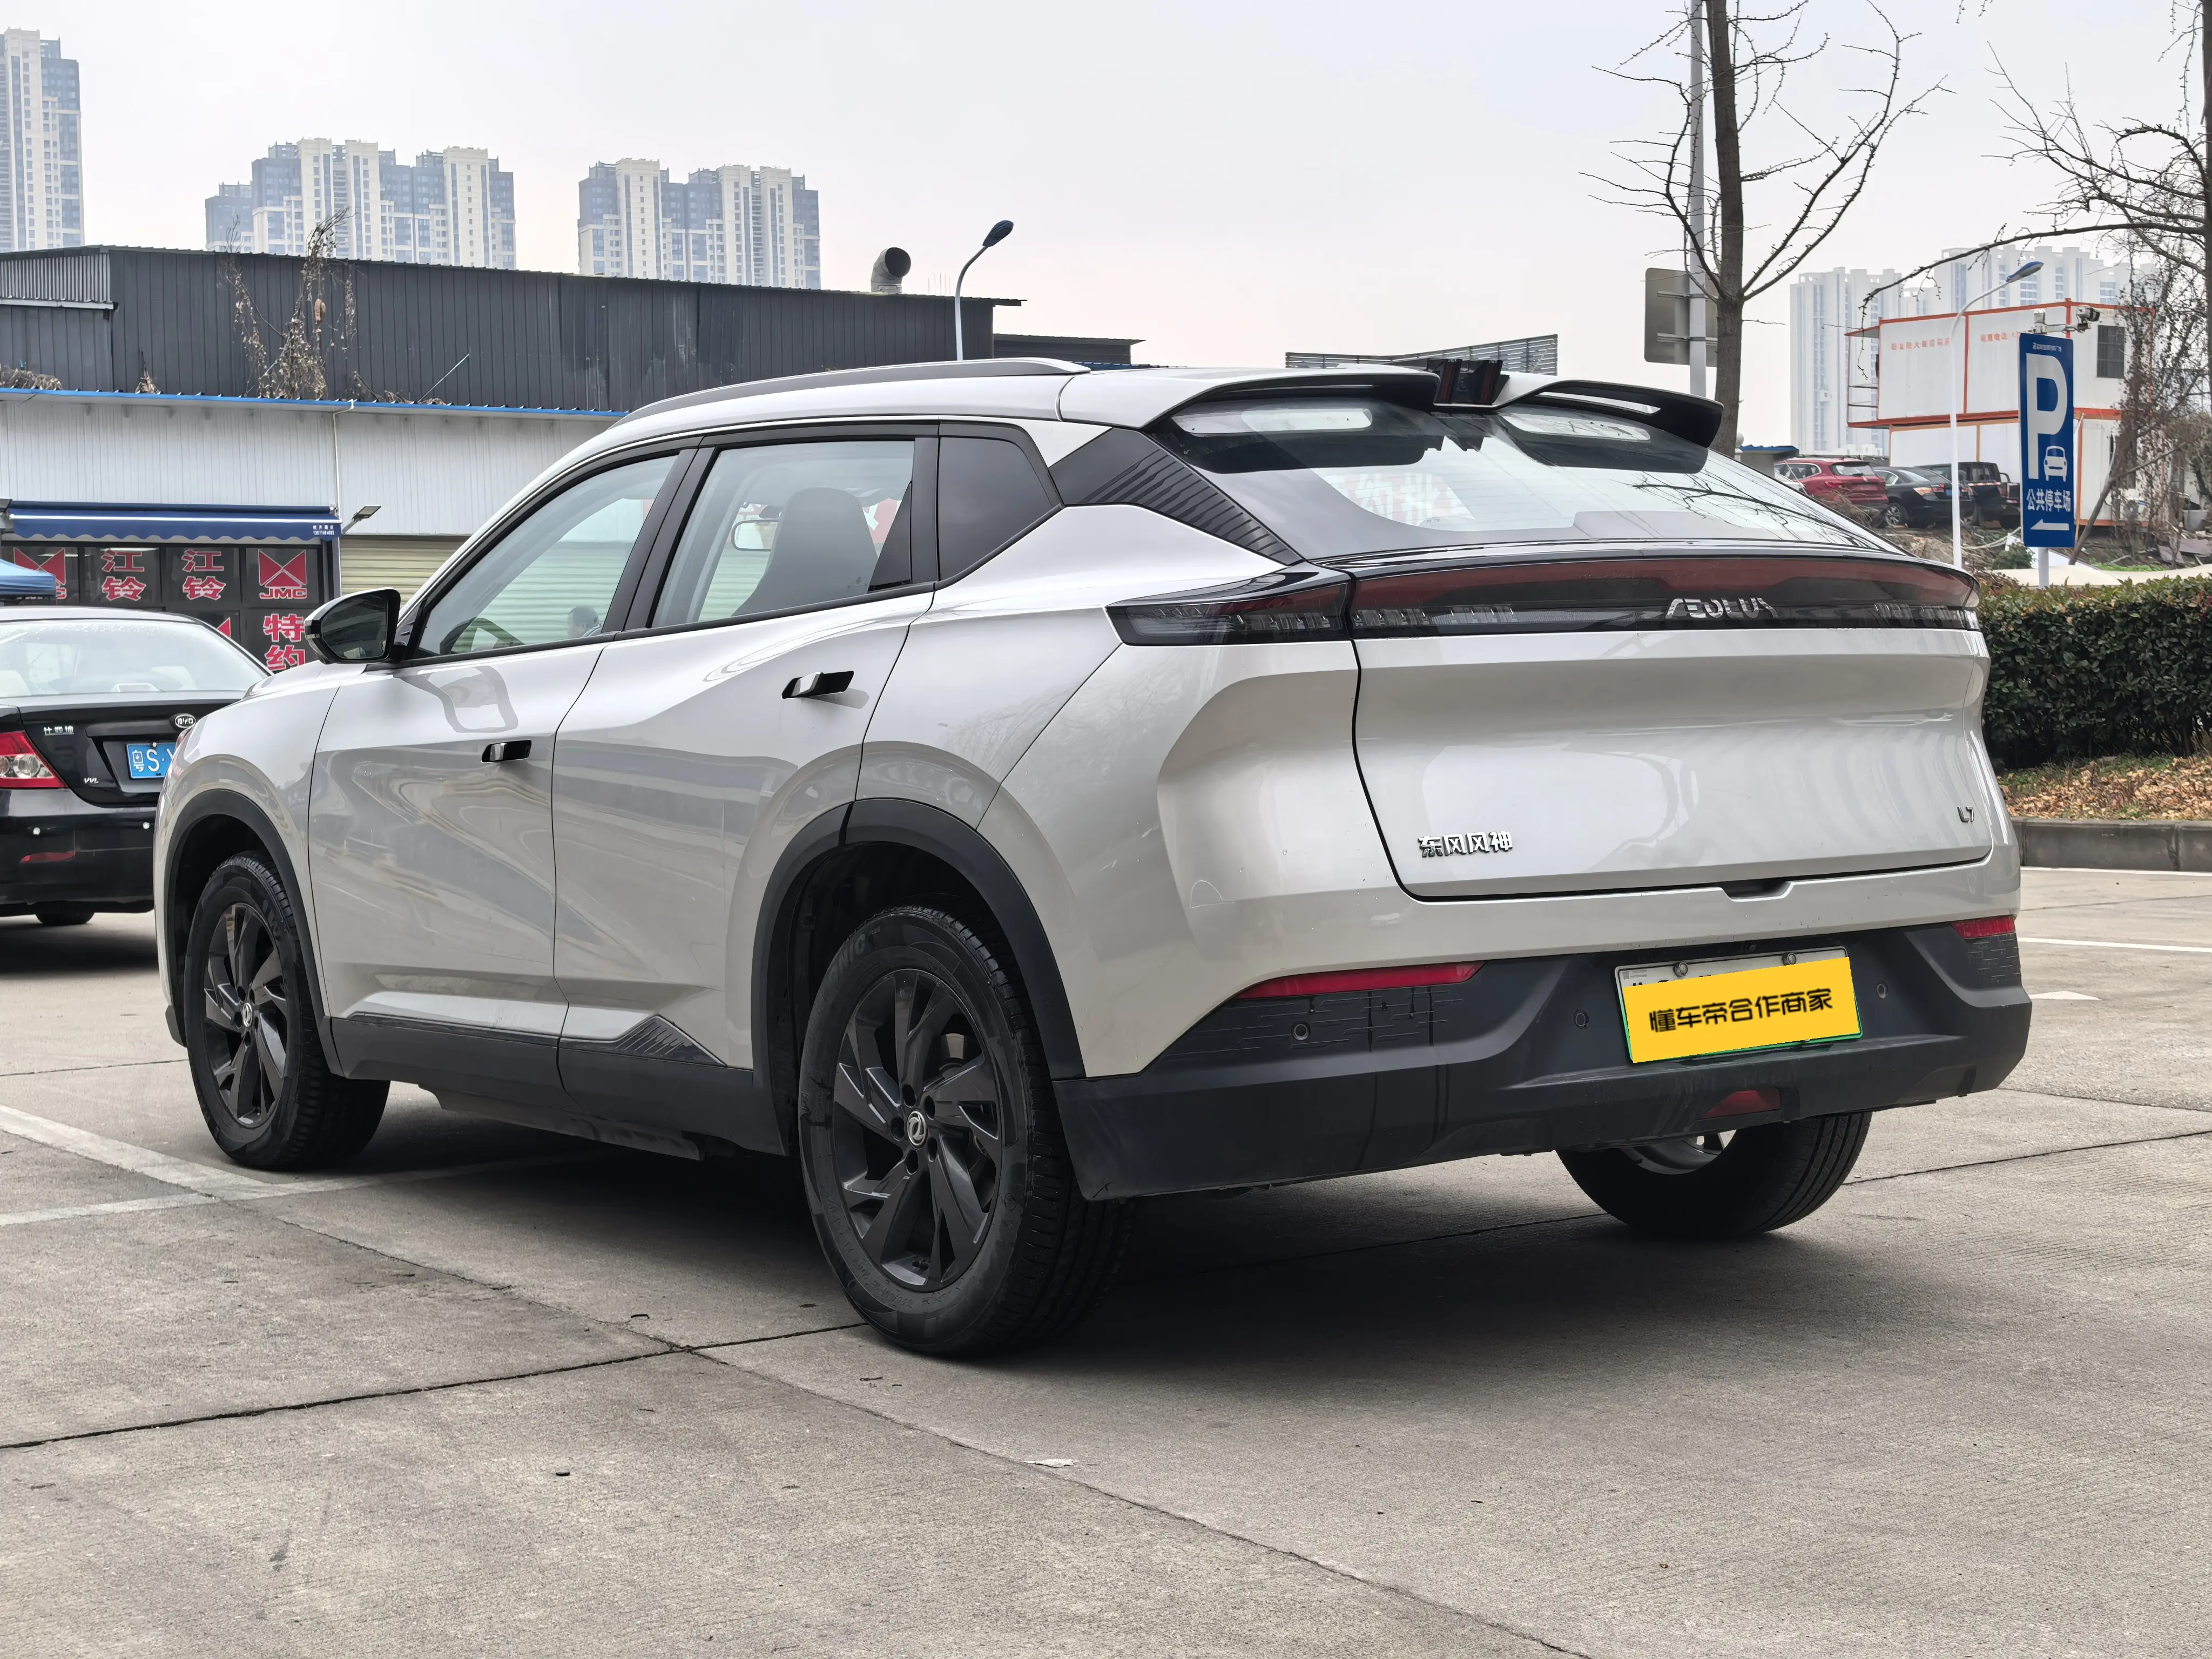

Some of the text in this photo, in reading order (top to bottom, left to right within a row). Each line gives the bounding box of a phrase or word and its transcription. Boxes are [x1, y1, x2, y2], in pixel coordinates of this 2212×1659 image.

[2026, 352, 2068, 480] P
[2027, 488, 2071, 512] 公共停车场
[101, 549, 147, 601] 江铃
[181, 549, 226, 601] 江铃
[259, 588, 307, 599] JMC
[263, 613, 306, 670] 特约
[1418, 831, 1513, 858] 东风风神
